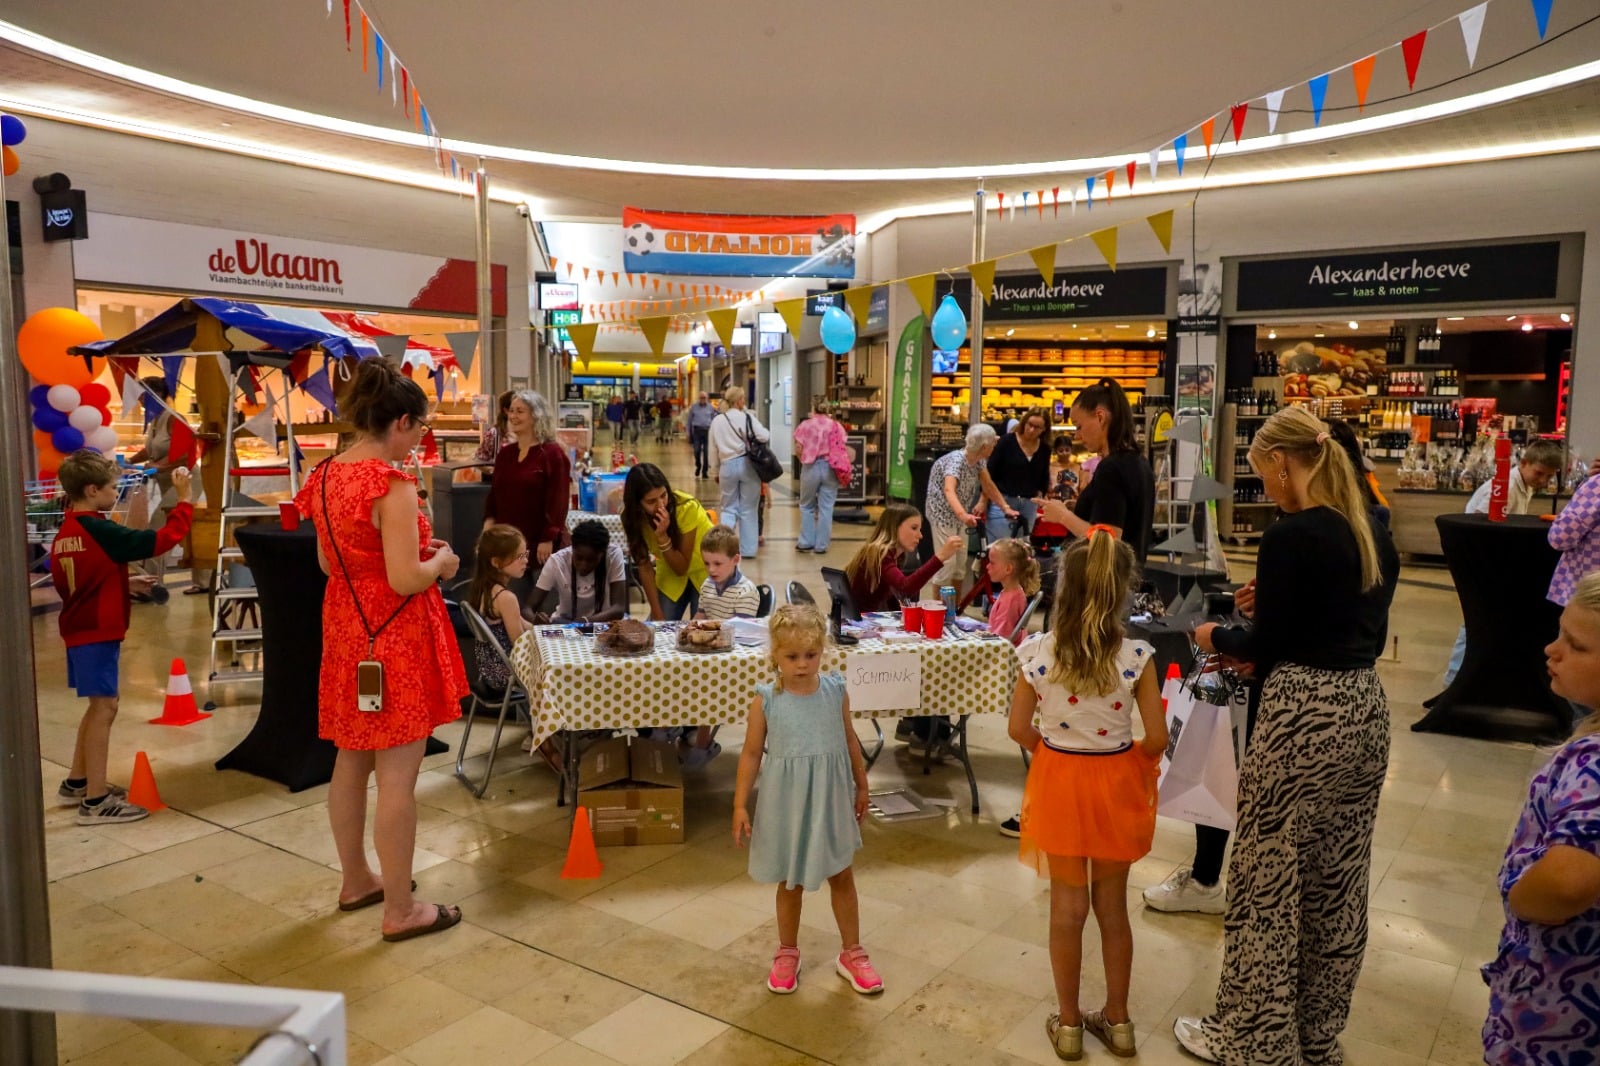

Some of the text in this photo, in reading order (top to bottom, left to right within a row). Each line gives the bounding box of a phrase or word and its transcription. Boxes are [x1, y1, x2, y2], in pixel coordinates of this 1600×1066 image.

[1308, 258, 1471, 285] Alexanderhoeve
[209, 273, 344, 295] Vlaambachtelijke banketbakkerij
[991, 279, 1105, 300] Alexanderhoeve
[1353, 286, 1419, 297] kaas & noten
[1013, 302, 1075, 312] Theo van Dongen
[897, 340, 915, 466] GRASKAAS
[852, 667, 916, 686] SCHMINK
